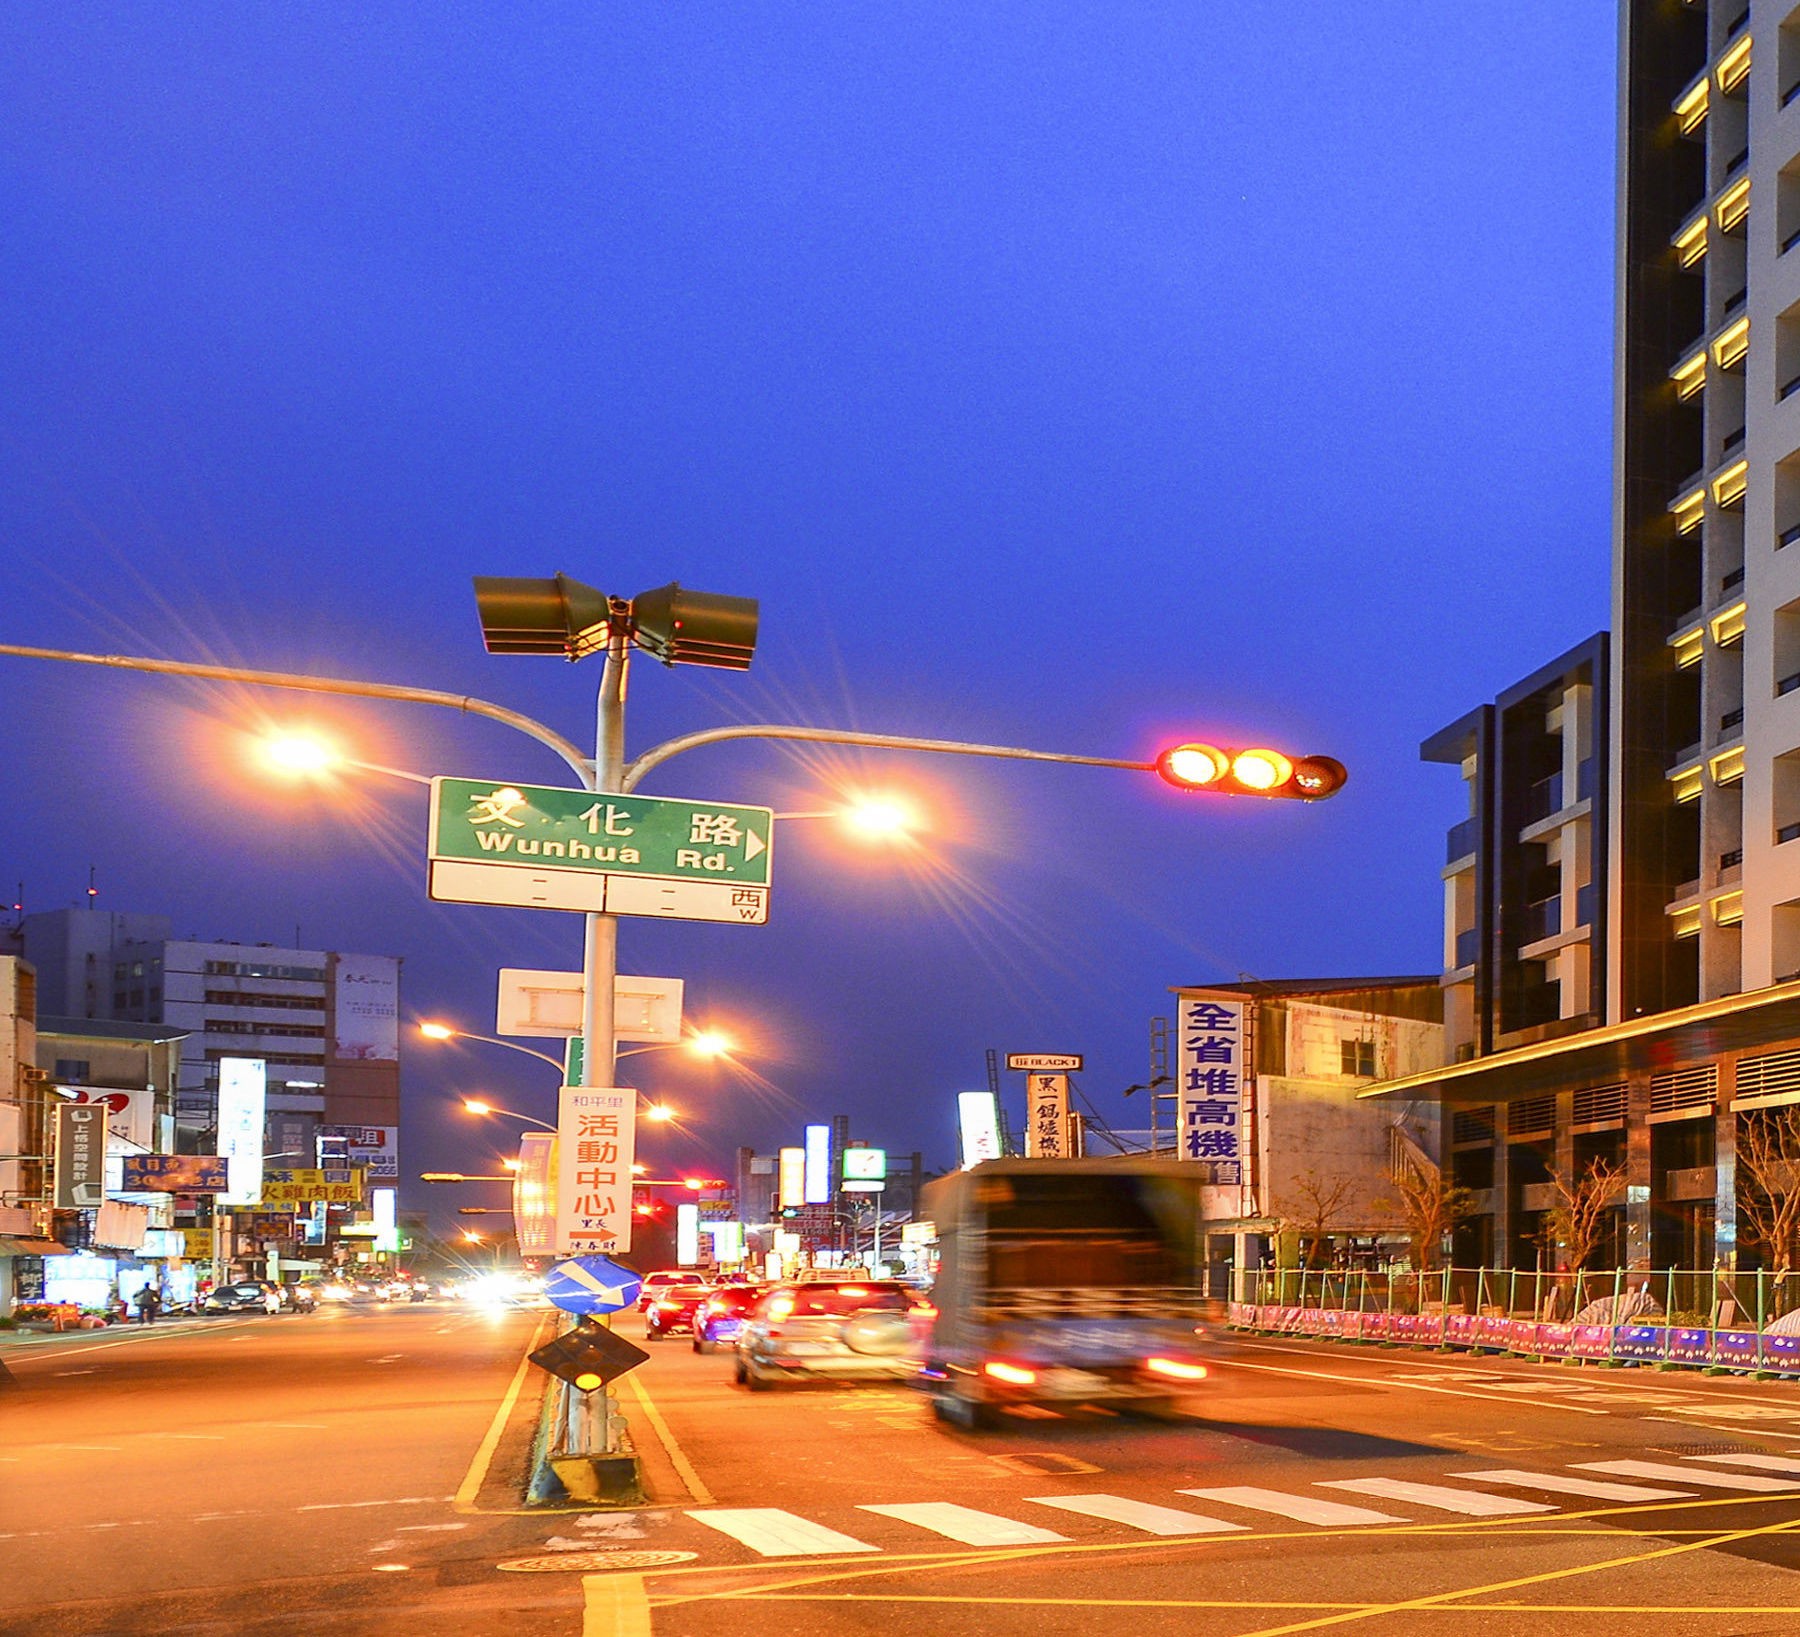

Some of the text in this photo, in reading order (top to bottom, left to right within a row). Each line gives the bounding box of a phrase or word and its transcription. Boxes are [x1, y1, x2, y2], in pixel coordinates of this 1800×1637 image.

[468, 791, 743, 847] 文化路
[475, 830, 735, 872] Wunhua Rd.
[731, 888, 763, 908] 西
[572, 1095, 624, 1108] 和平里
[1186, 1003, 1238, 1158] 全省堆高機
[573, 1113, 619, 1217] 活動中心
[262, 1184, 357, 1200] 火雞肉飯
